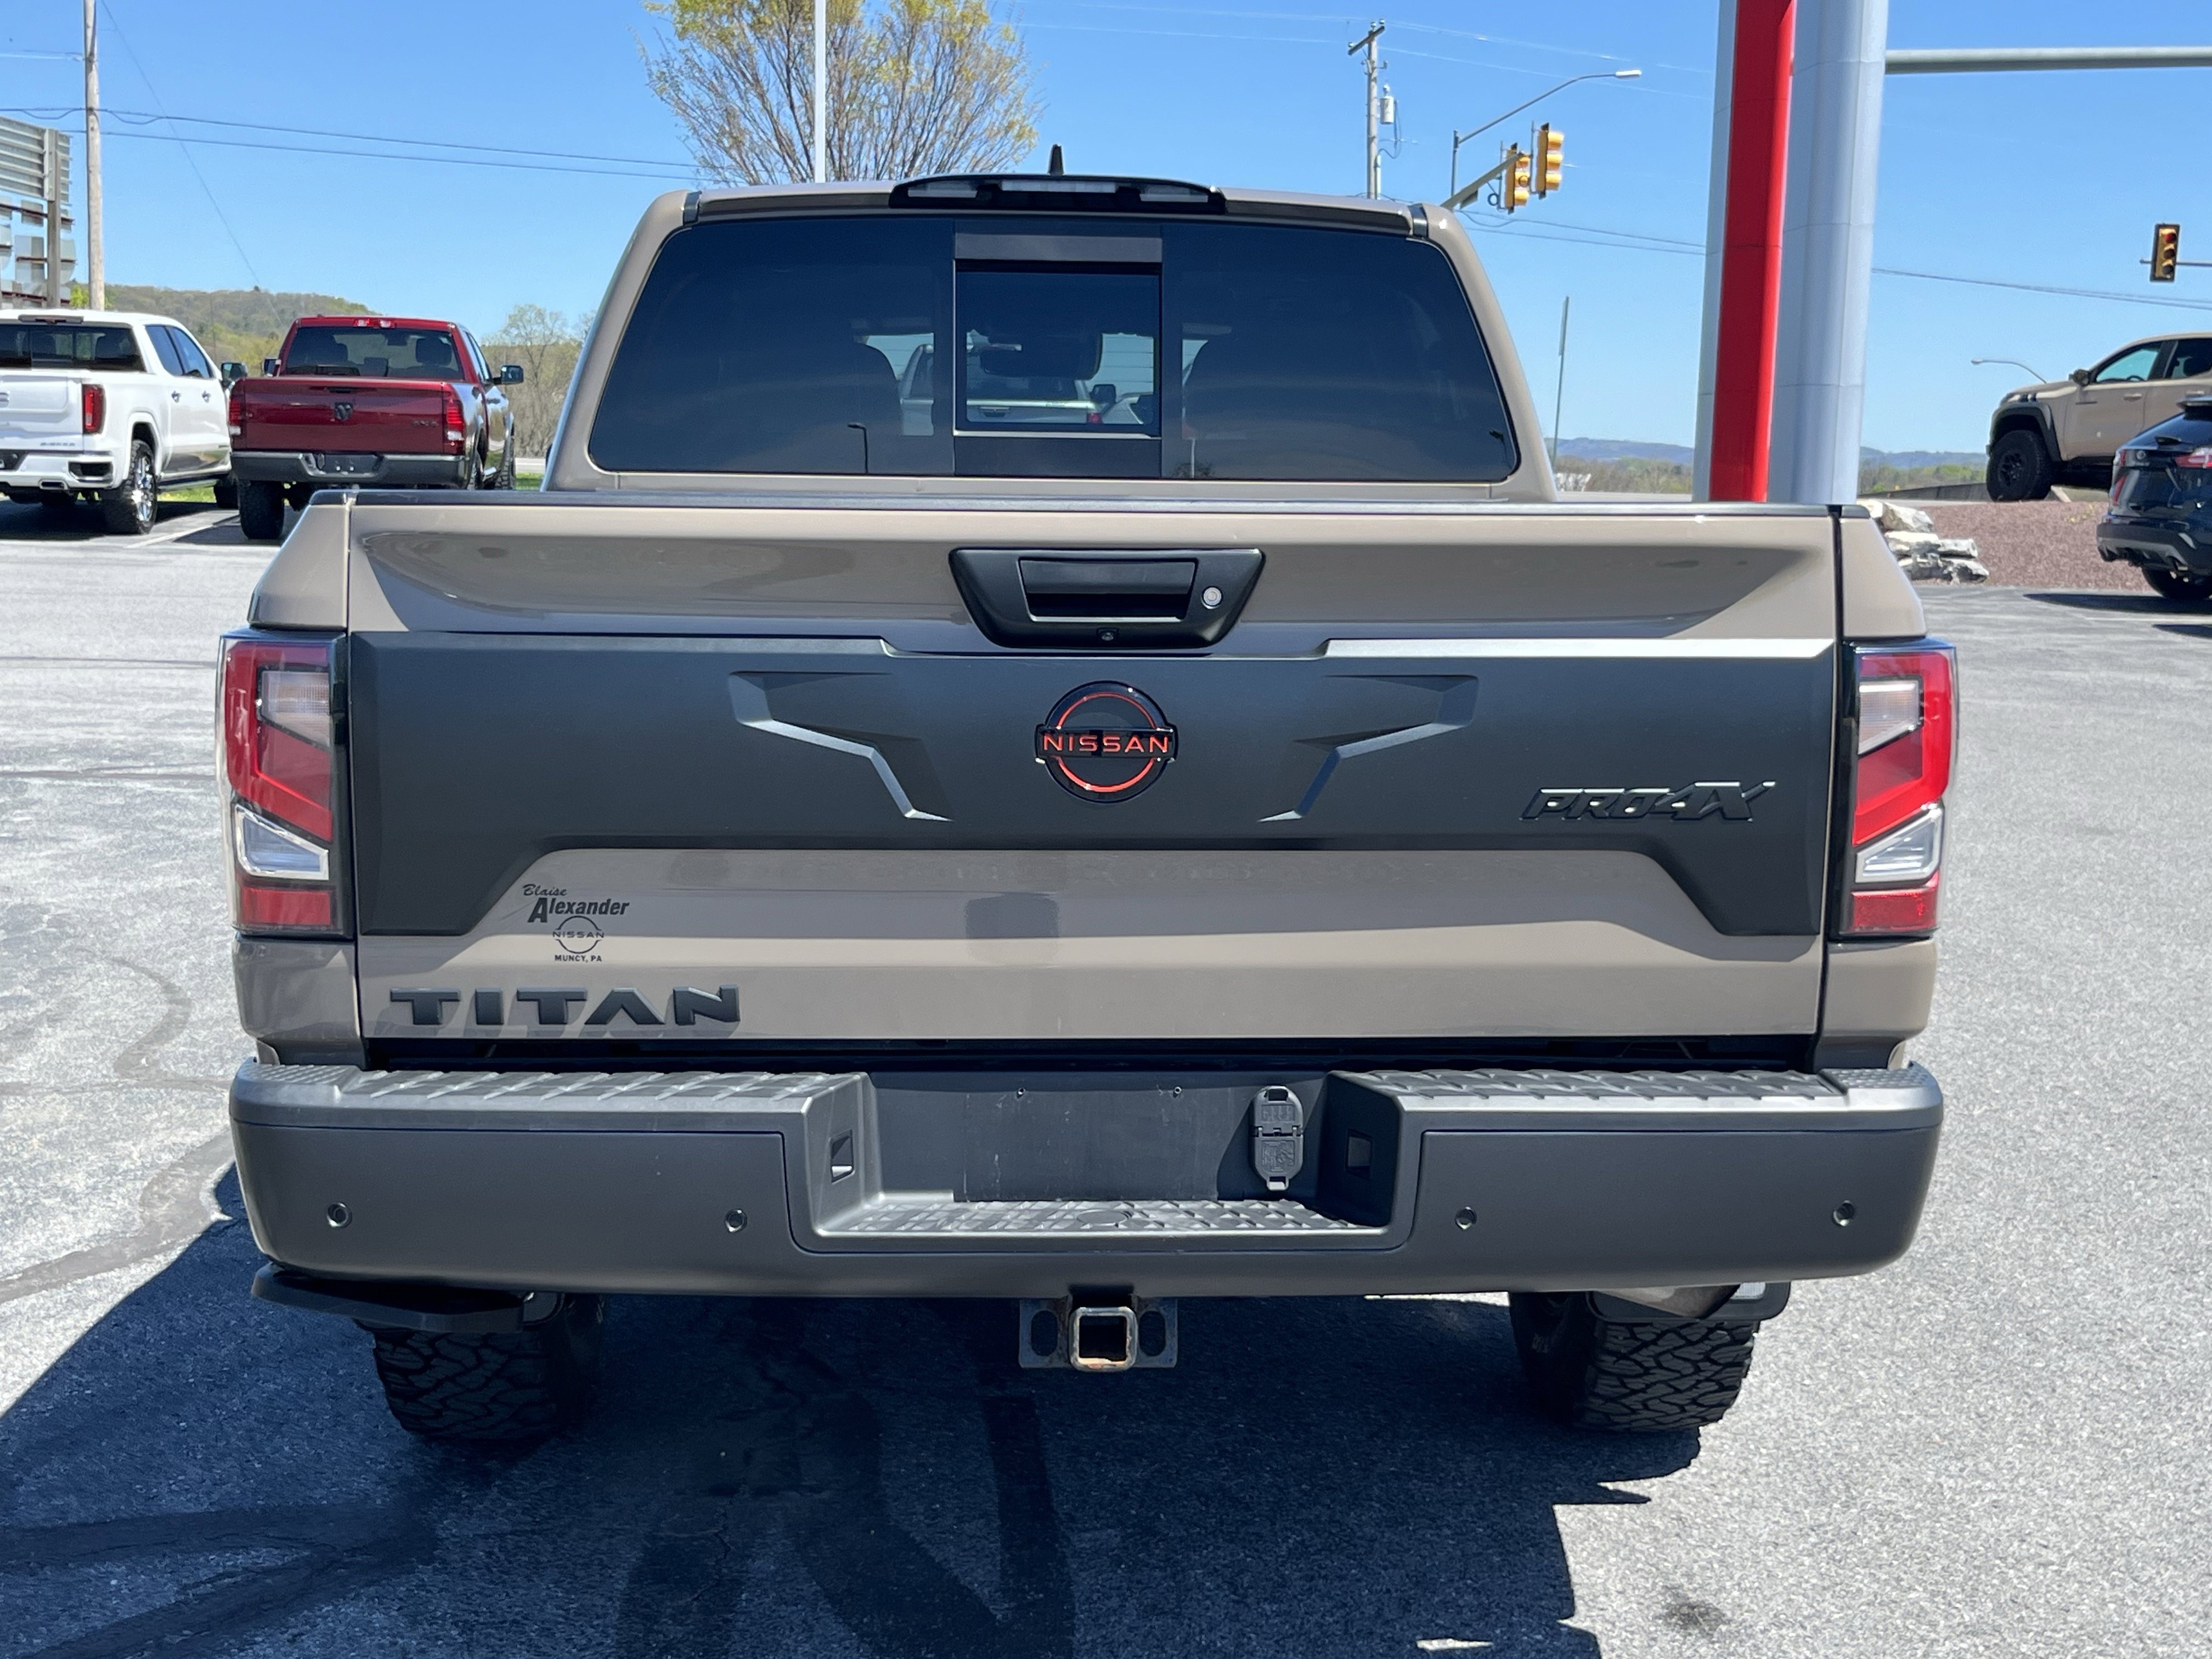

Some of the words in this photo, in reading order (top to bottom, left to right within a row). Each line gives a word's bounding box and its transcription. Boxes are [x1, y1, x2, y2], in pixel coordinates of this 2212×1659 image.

[1043, 734, 1169, 753] NISSAN
[523, 884, 567, 896] Blaise
[527, 898, 630, 923] Alexander
[390, 984, 741, 1025] TITAN
